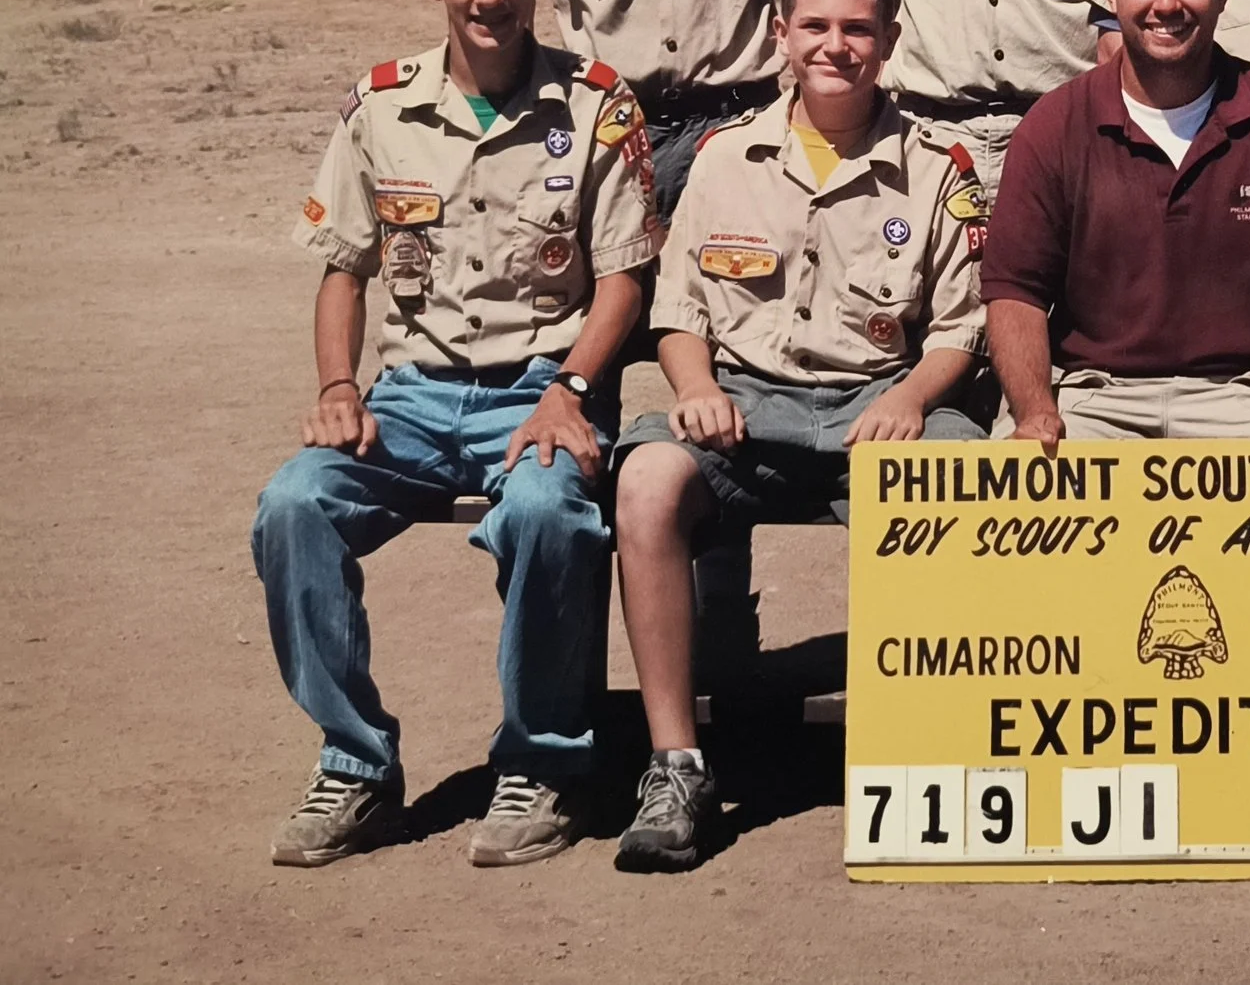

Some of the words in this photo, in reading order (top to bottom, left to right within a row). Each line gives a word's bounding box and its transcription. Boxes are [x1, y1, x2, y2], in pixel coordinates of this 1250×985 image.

[880, 457, 1119, 502] PHILMONT
[876, 516, 959, 556] BOY
[971, 516, 1119, 556] SCOUTS
[1148, 516, 1202, 555] OF
[877, 635, 1080, 676] CIMARRON
[863, 784, 1013, 845] 719
